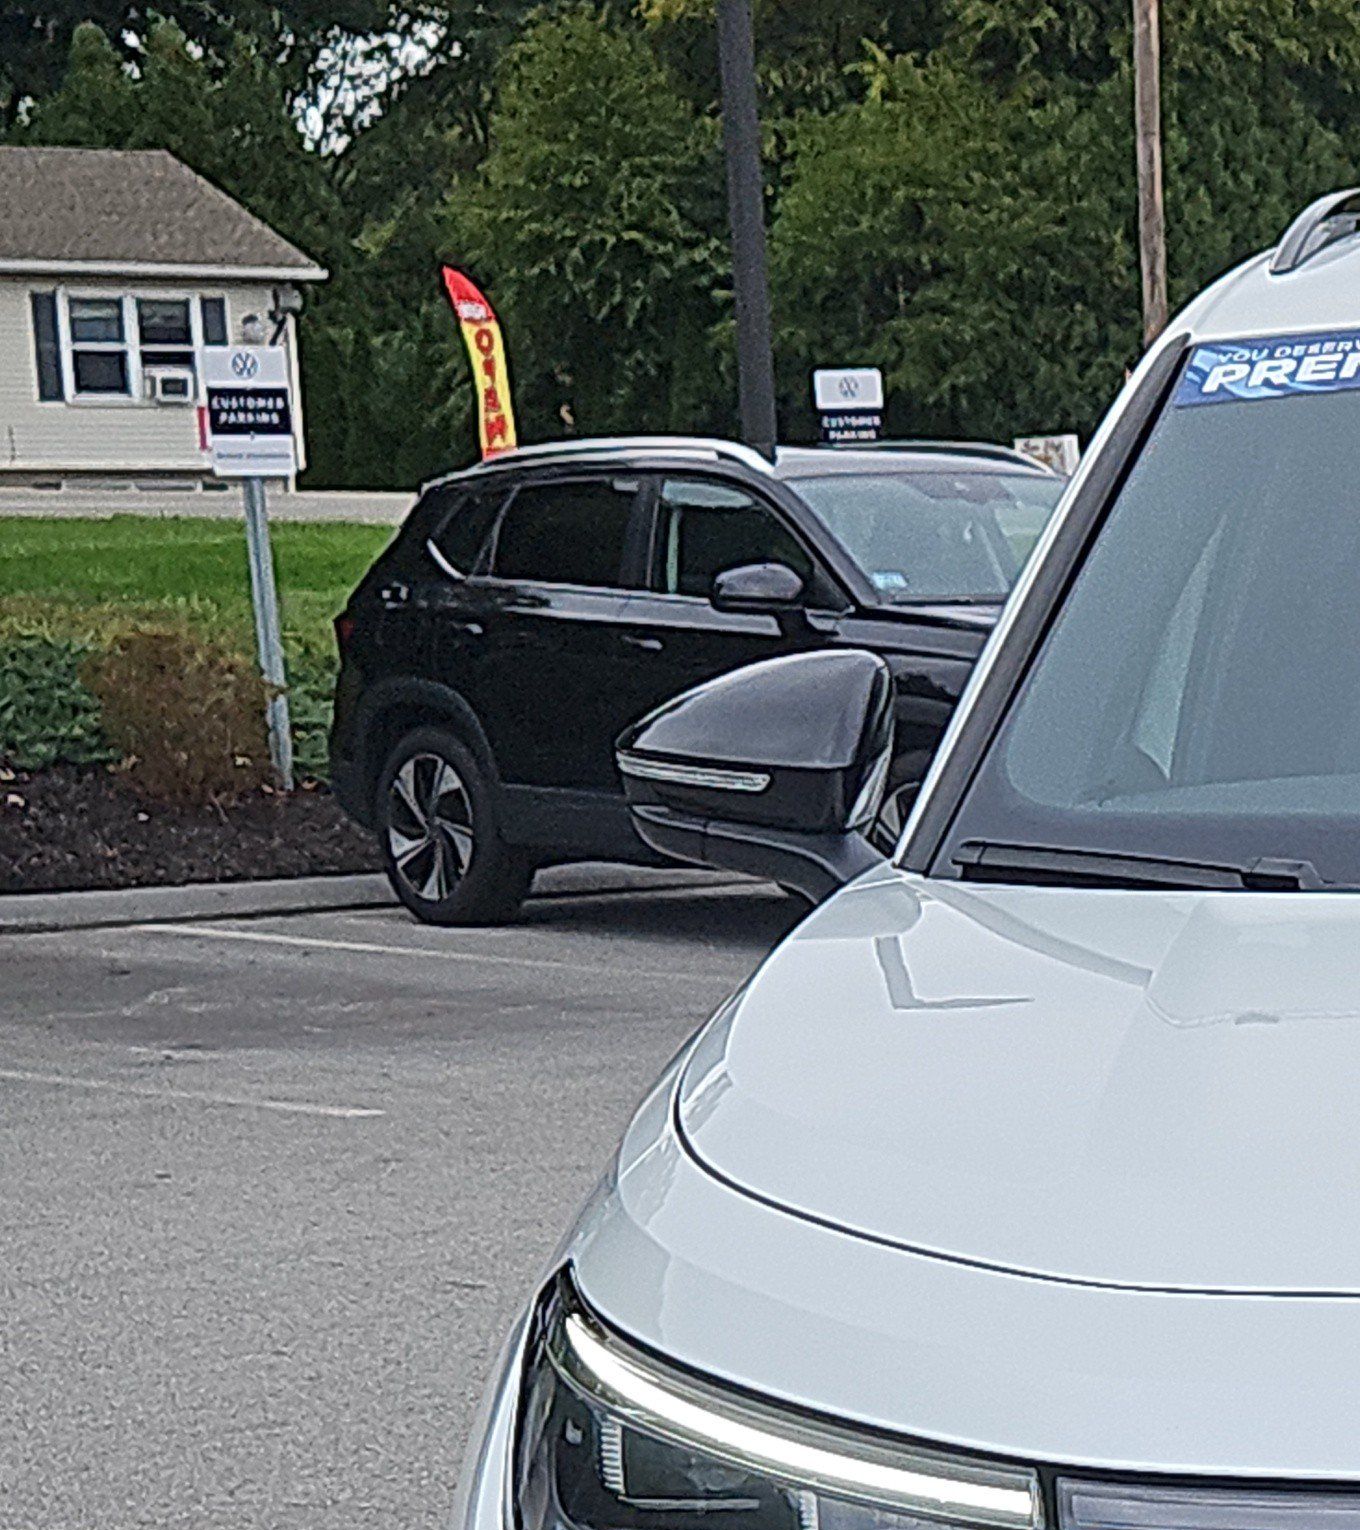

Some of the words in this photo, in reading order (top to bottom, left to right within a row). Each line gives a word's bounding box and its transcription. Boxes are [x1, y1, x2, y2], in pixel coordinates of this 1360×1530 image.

[1217, 348, 1269, 363] YOU
[211, 395, 285, 410] CUSTOMER
[218, 411, 280, 425] PARKING
